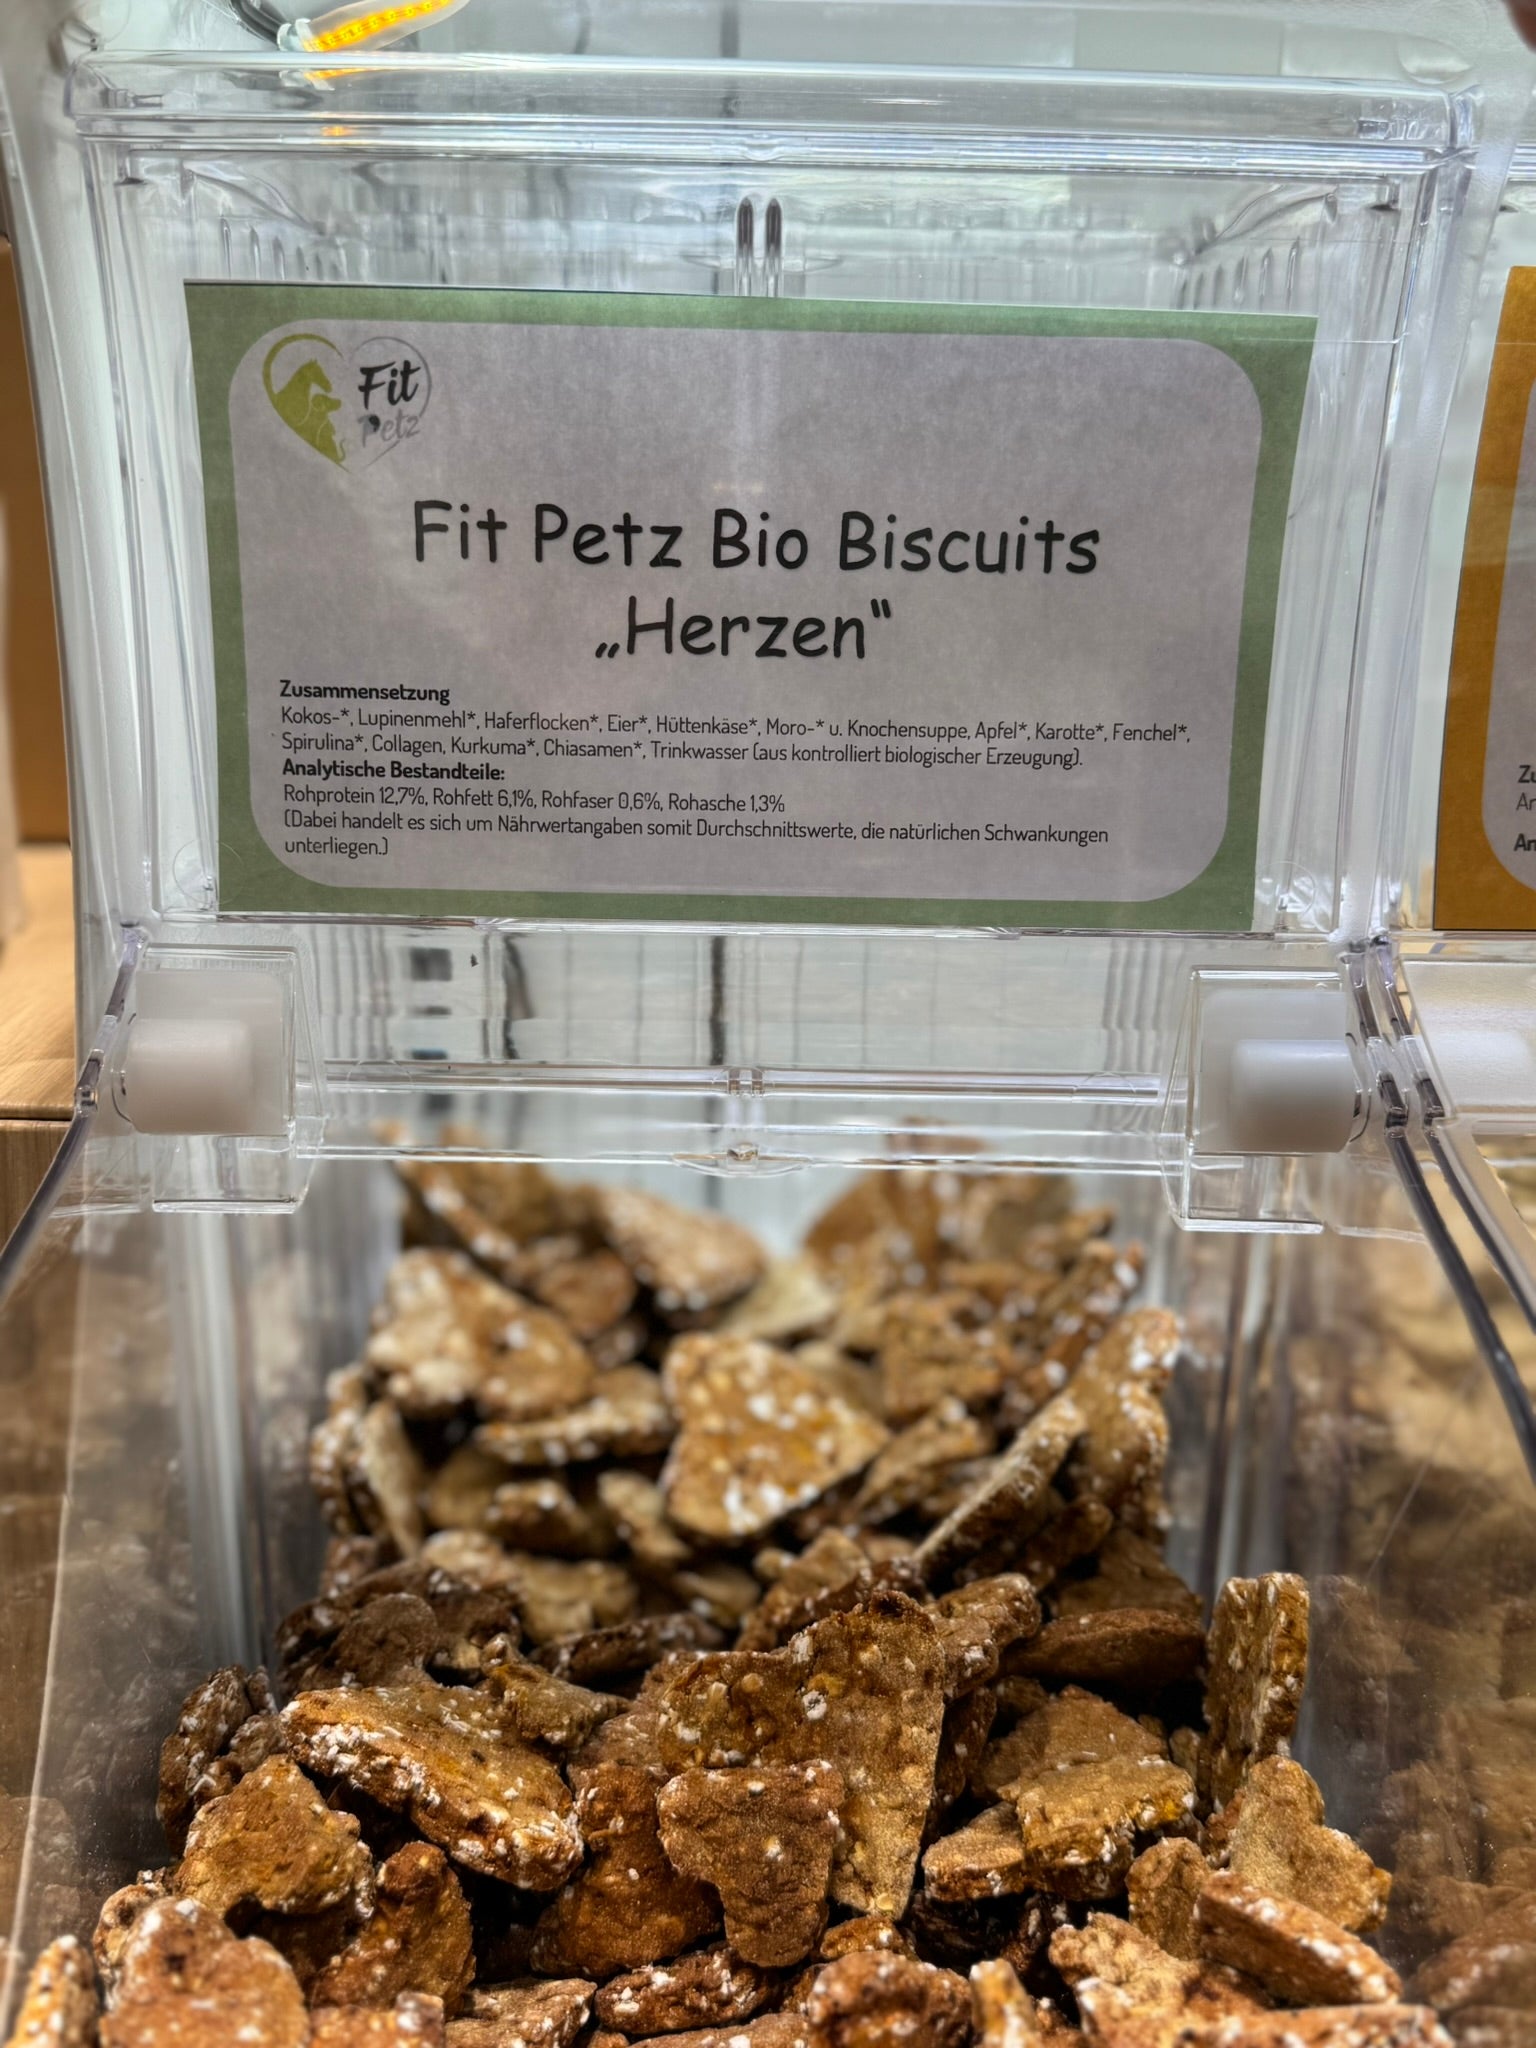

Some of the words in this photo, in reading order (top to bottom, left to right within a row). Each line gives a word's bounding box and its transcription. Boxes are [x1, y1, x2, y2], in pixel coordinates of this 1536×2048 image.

[358, 360, 421, 410] Fit
[414, 500, 507, 563] Fit
[535, 503, 683, 568] Petz
[713, 508, 808, 570] Bio
[839, 511, 1100, 574] Biscuits
[280, 680, 450, 706] Zusammensetzung
[829, 724, 842, 736] u.
[848, 720, 971, 743] Knochensuppe,
[372, 734, 446, 758] Collagen,
[650, 740, 749, 760] Trinkwasser
[753, 742, 787, 760] (aus
[792, 744, 881, 762] kontrolliert
[885, 745, 982, 768] biologischer
[283, 758, 386, 781] Analytische
[391, 760, 505, 780] Bestandteile:
[284, 784, 374, 807] Rohprotein
[433, 787, 493, 806] Rohfett
[542, 790, 614, 809] Rohfaser
[669, 793, 746, 811] Rohasche
[285, 809, 336, 828] (Dabei
[342, 811, 403, 829] handelt
[408, 818, 425, 830] es
[430, 813, 461, 831] sich
[466, 819, 492, 831] um
[498, 814, 643, 839] Nährwertangaben
[647, 819, 692, 836] somit
[697, 819, 857, 840] Durchschnittswerte,
[861, 821, 885, 839] die
[890, 822, 980, 840] natürlichen
[984, 824, 1108, 847] Schwankungen
